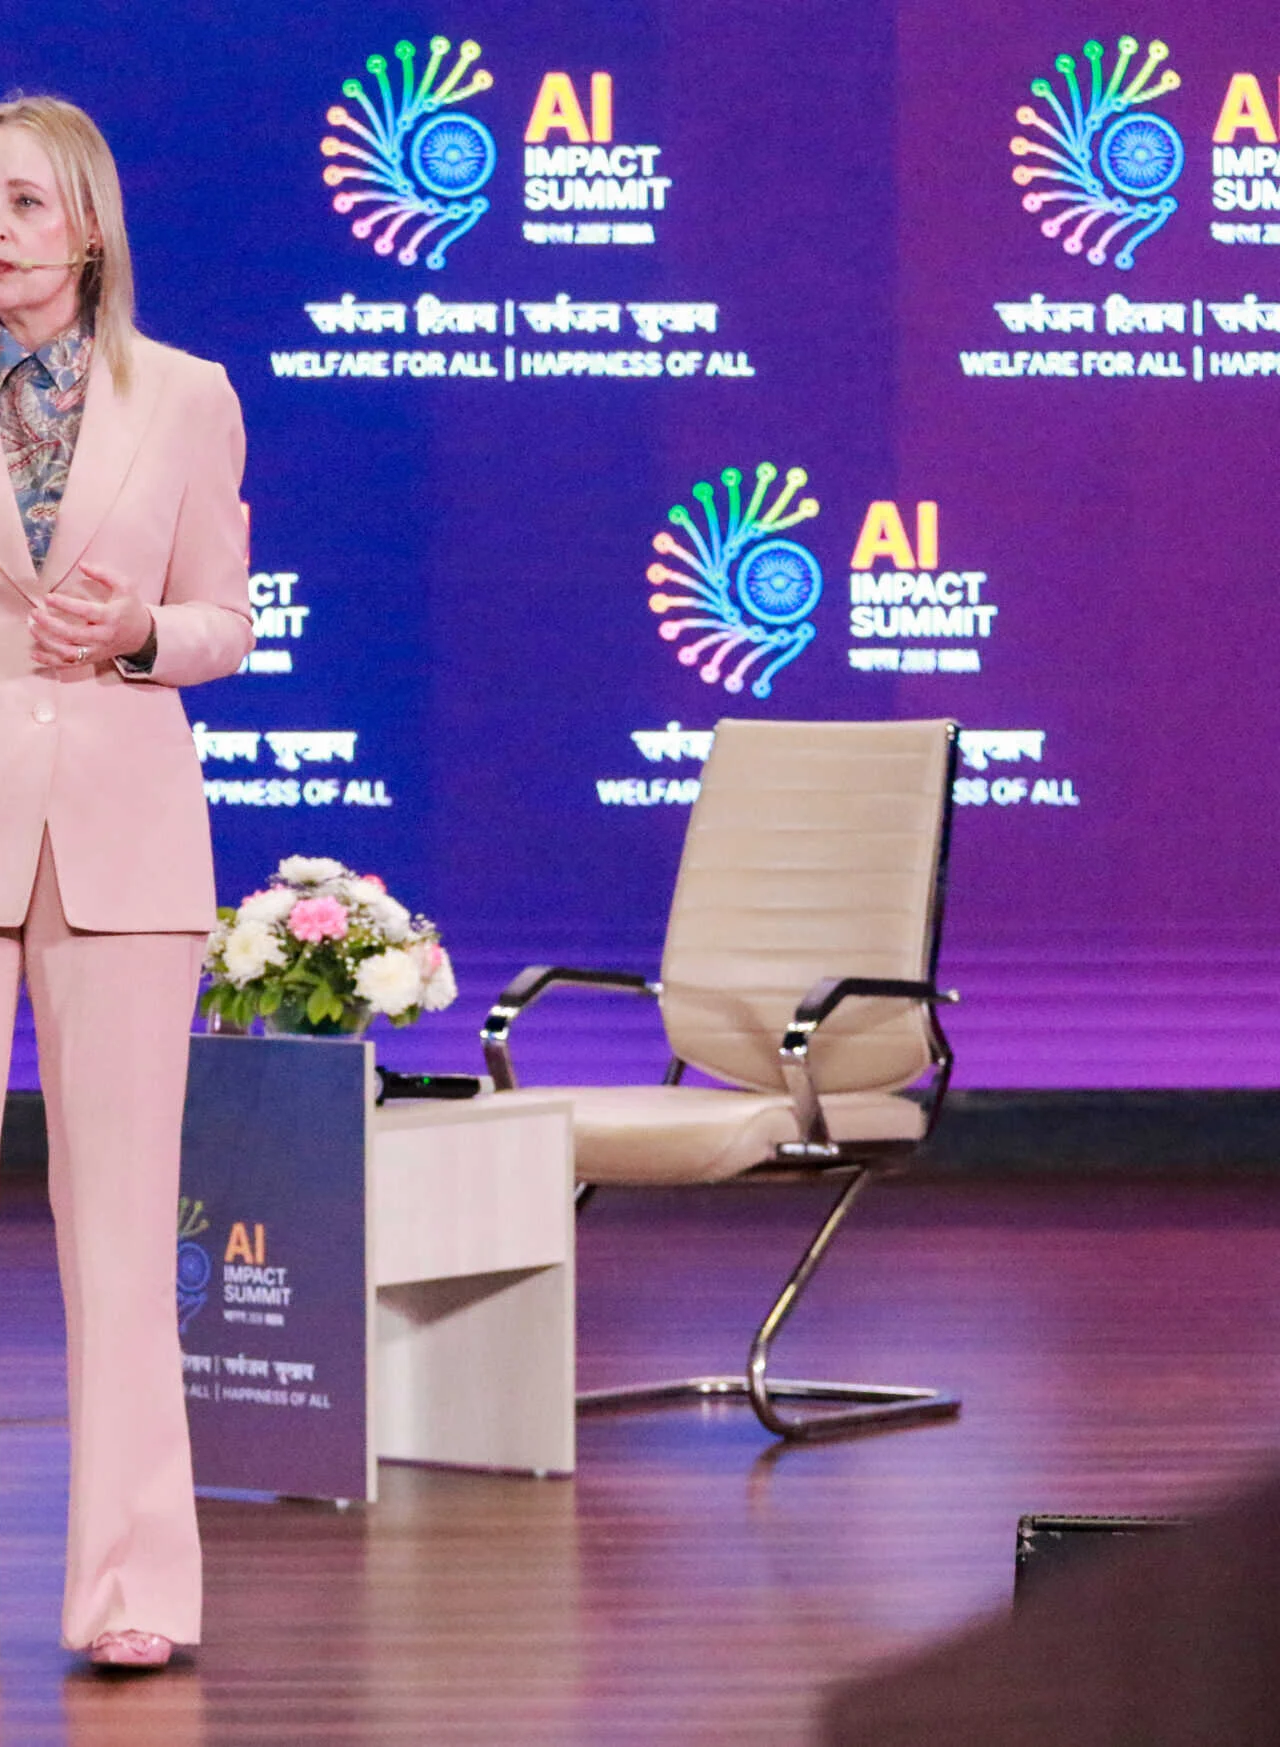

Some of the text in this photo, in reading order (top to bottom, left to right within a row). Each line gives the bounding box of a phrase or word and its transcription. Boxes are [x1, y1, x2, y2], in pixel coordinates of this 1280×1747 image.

[523, 70, 613, 143] AI
[1212, 72, 1280, 143] A
[524, 145, 662, 175] IMPACT
[524, 175, 673, 211] SUMMIT
[270, 350, 756, 377] WELFARE FOR ALL HAPPINESS OF ALL
[959, 351, 1080, 376] WELFARE
[1081, 350, 1135, 376] FOR
[1136, 351, 1187, 376] ALL
[849, 499, 939, 570] AI
[849, 571, 987, 603] IMPACT
[252, 606, 310, 638] MIT
[849, 603, 999, 637] SUMMIT
[204, 779, 392, 806] PINESS OF ALL
[596, 779, 700, 805] WELFAR
[990, 777, 1028, 805] OF
[1030, 778, 1079, 805] ALL
[223, 1222, 266, 1265] AI
[224, 1264, 287, 1285] IMPACT
[224, 1285, 291, 1307] SUMMIT
